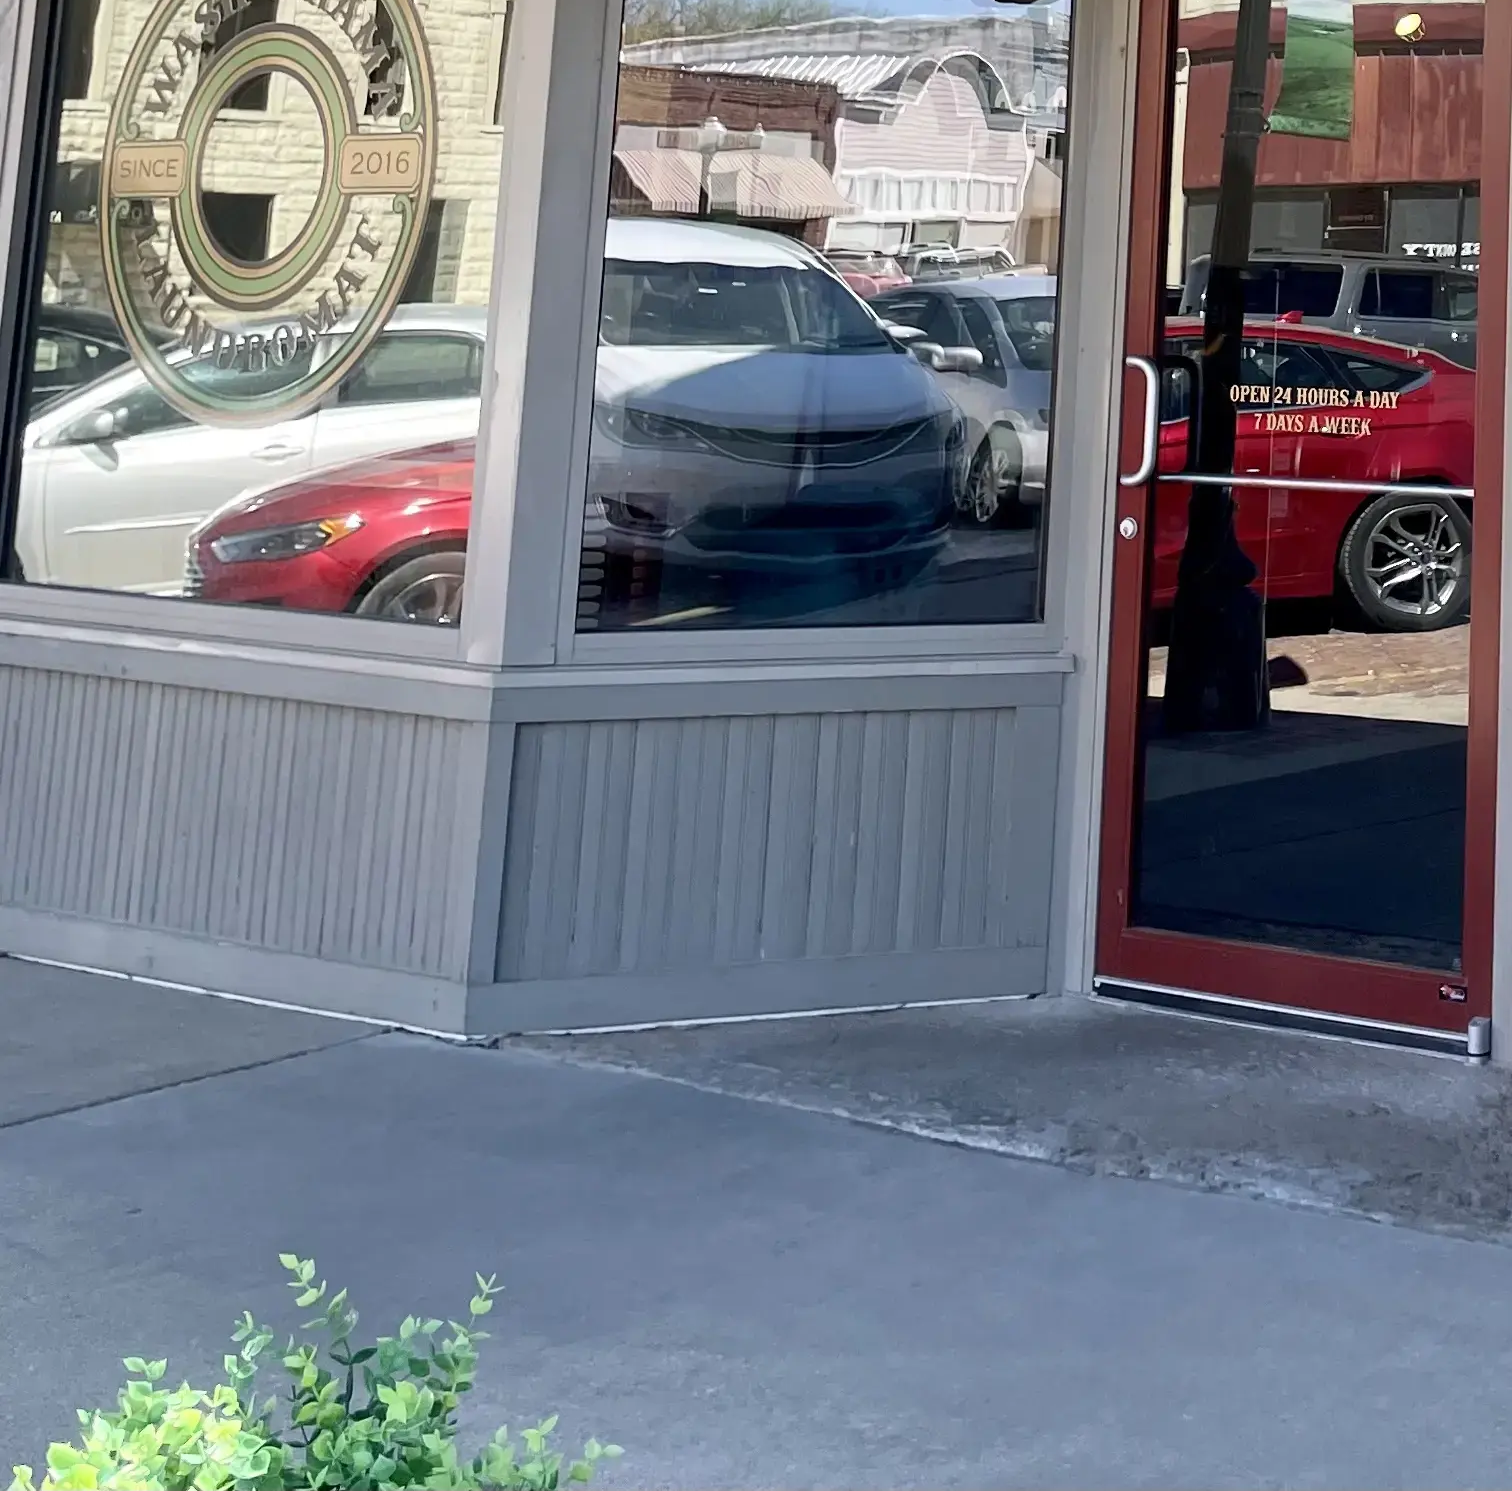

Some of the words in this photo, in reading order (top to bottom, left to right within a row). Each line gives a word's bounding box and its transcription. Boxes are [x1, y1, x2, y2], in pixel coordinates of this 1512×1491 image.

[119, 158, 179, 180] SINCE
[350, 150, 411, 177] 2016
[133, 213, 384, 374] LAUNDROMAT
[1229, 384, 1271, 404] OPEN
[1274, 386, 1292, 405] 24
[1296, 387, 1350, 408] HOURS
[1353, 390, 1366, 408] A
[1369, 390, 1401, 410] DAY
[1254, 413, 1263, 430] 7
[1266, 413, 1304, 433] DAYS
[1308, 416, 1319, 433] A
[1324, 416, 1372, 436] WEEK
